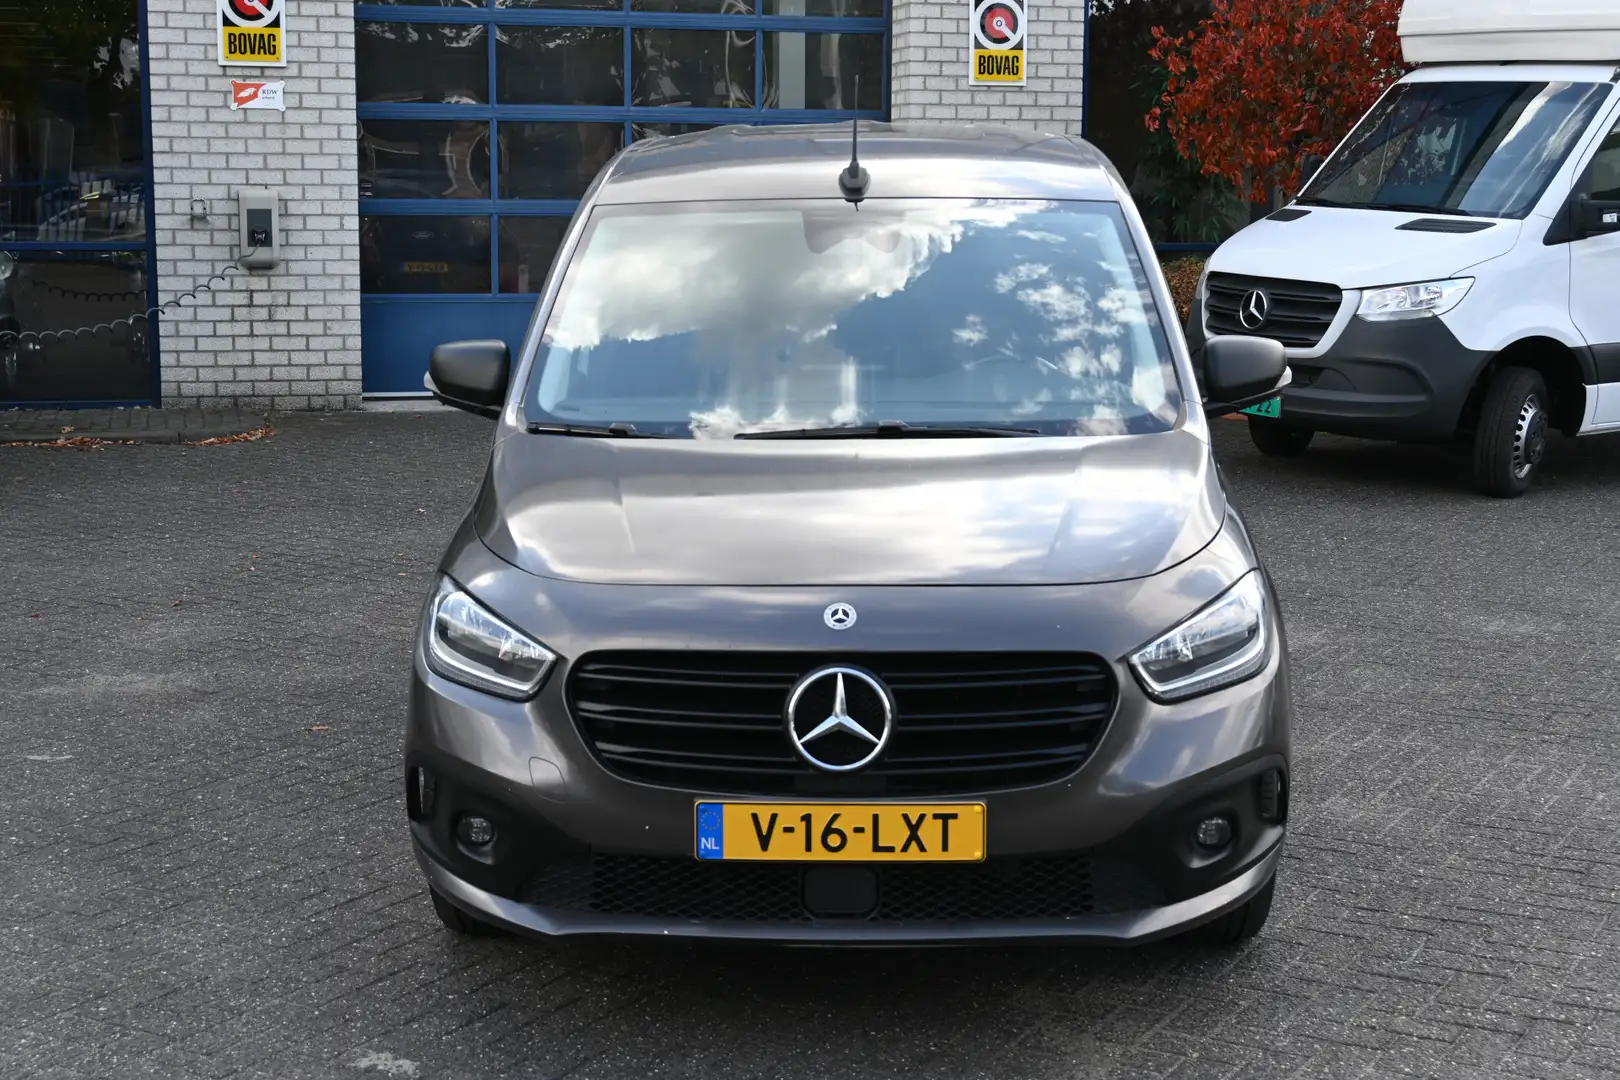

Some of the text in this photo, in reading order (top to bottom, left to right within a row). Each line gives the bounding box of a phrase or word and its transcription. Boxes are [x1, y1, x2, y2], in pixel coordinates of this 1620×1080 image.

[228, 33, 277, 56] BOVAG
[978, 55, 1019, 76] BOVAG
[701, 812, 959, 853] NL V-16-LXT
